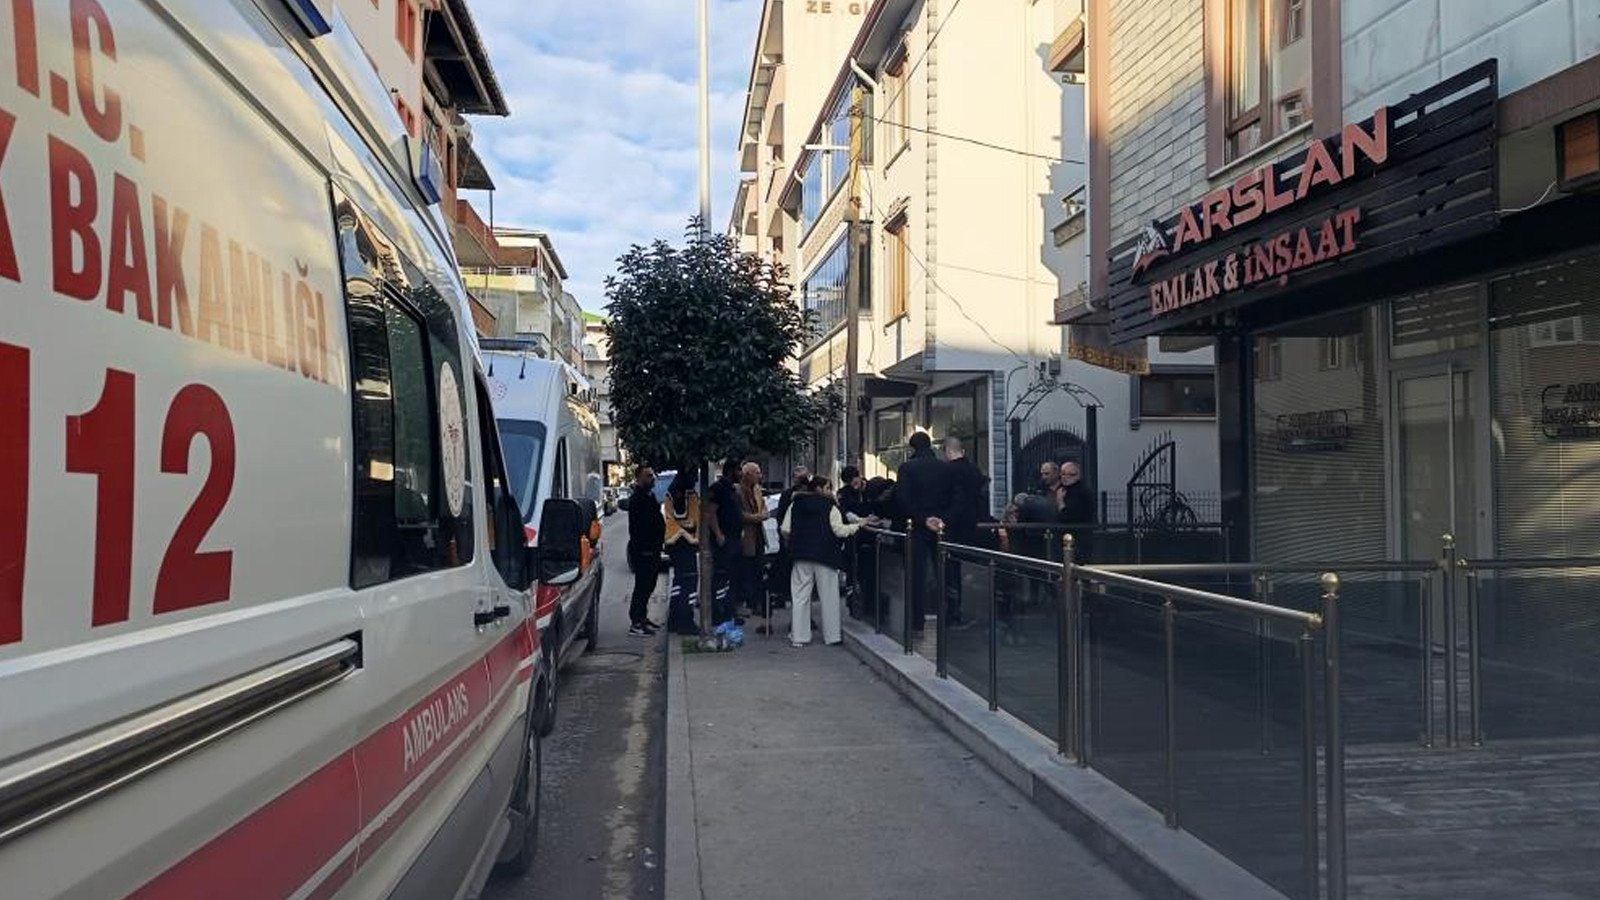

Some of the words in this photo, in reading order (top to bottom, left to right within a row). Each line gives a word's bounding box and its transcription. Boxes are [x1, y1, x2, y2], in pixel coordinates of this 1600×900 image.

[1172, 104, 1388, 252] ARSLAN
[47, 133, 329, 385] BAKANLIĞI
[1149, 259, 1221, 316] EMLAK
[1223, 252, 1240, 291] &
[1243, 204, 1362, 287] İNŞAAT
[402, 682, 469, 773] AMBULANS
